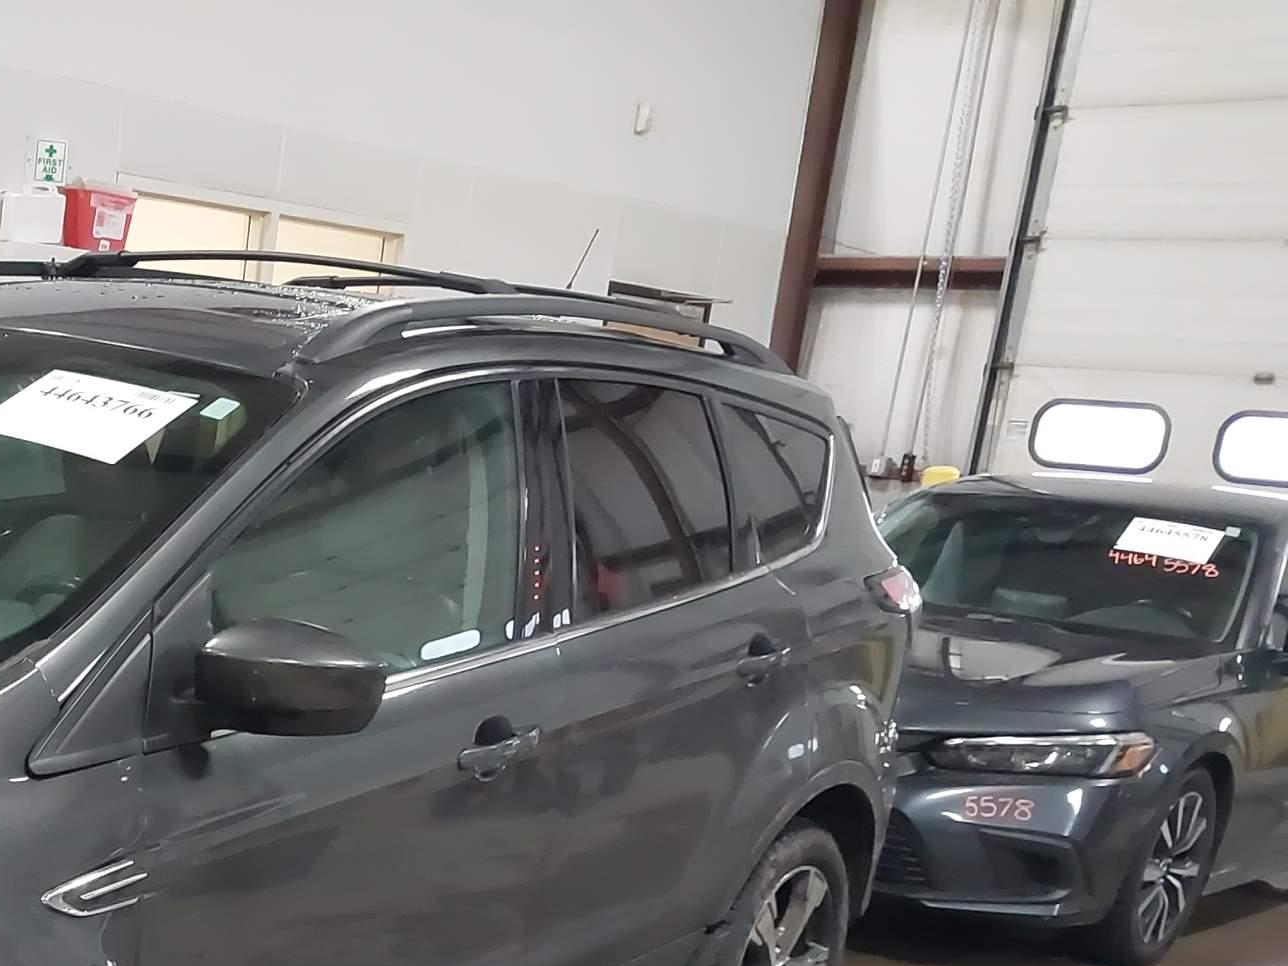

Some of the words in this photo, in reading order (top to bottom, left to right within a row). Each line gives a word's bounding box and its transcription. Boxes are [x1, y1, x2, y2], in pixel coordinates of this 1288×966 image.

[38, 157, 62, 167] FIRST
[42, 166, 57, 174] AID
[40, 386, 157, 419] 44643766
[1108, 549, 1158, 568] 4464
[1163, 558, 1220, 578] 5578
[965, 795, 1035, 821] 5578
